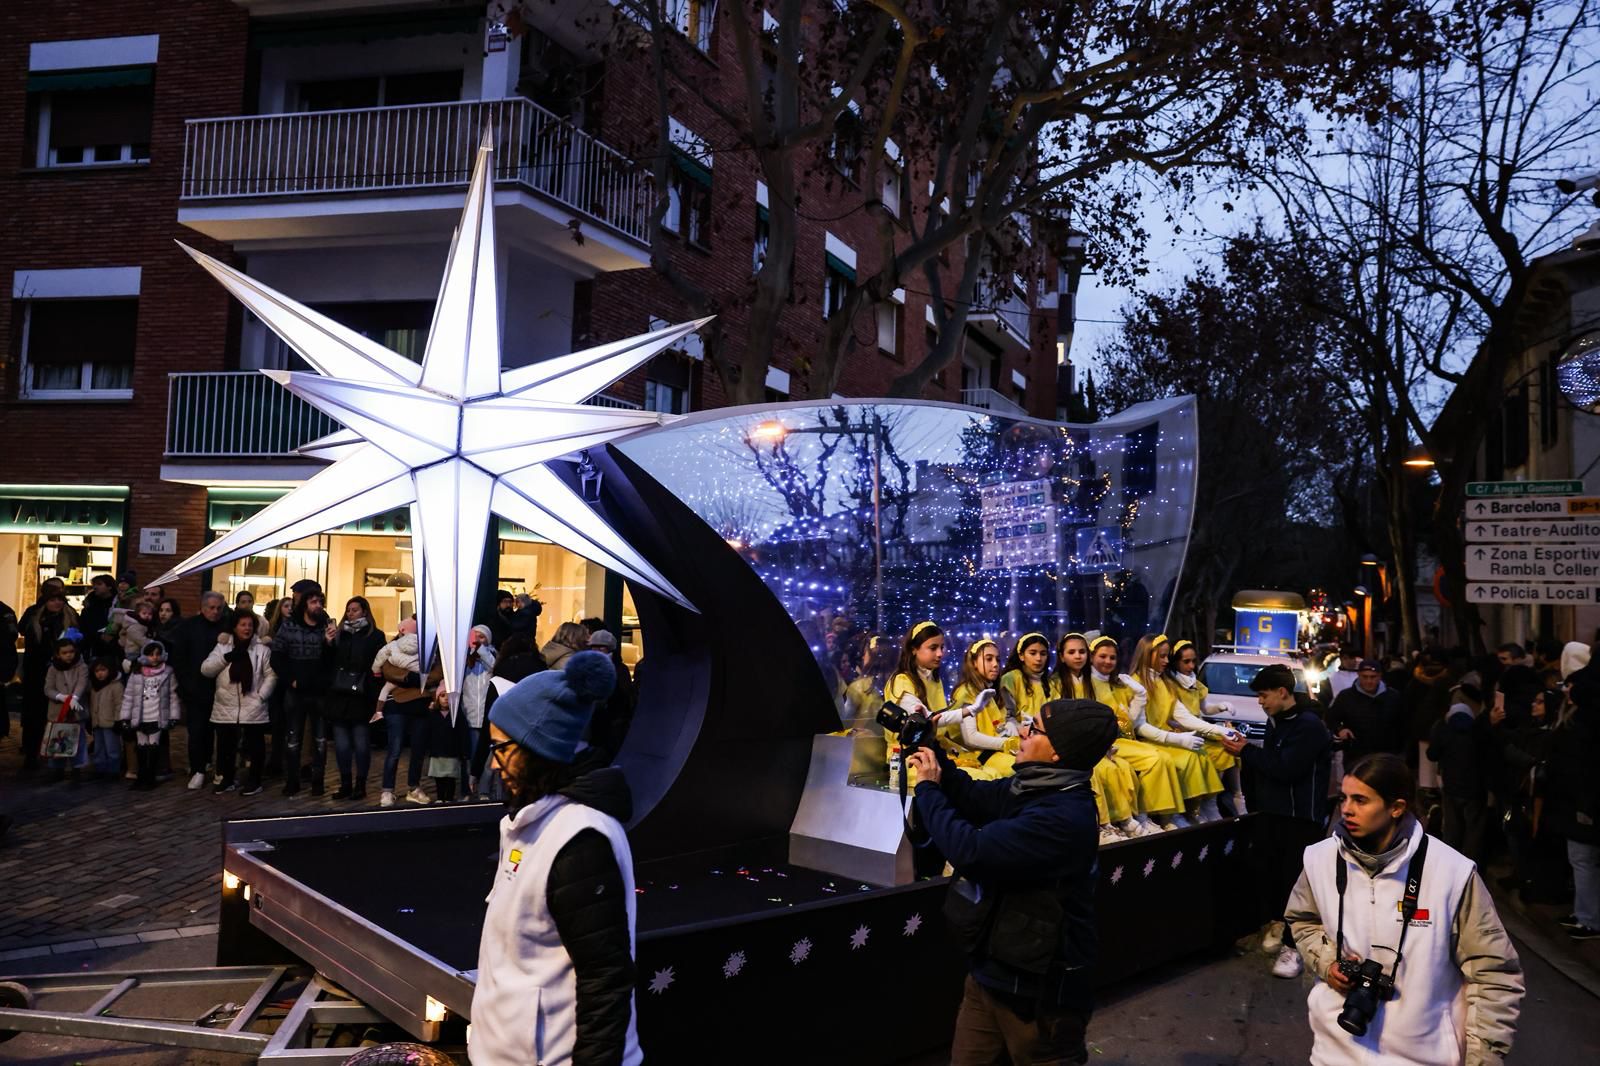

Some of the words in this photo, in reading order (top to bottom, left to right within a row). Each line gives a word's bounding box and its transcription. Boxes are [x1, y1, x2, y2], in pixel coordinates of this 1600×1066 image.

[1491, 501, 1562, 514] Barcelona
[1491, 548, 1528, 560] Zona
[1491, 563, 1546, 576] Rambla
[1553, 563, 1598, 576] Celler
[1491, 586, 1540, 599] Policia
[1546, 587, 1590, 600] Local
[1258, 616, 1273, 632] G
